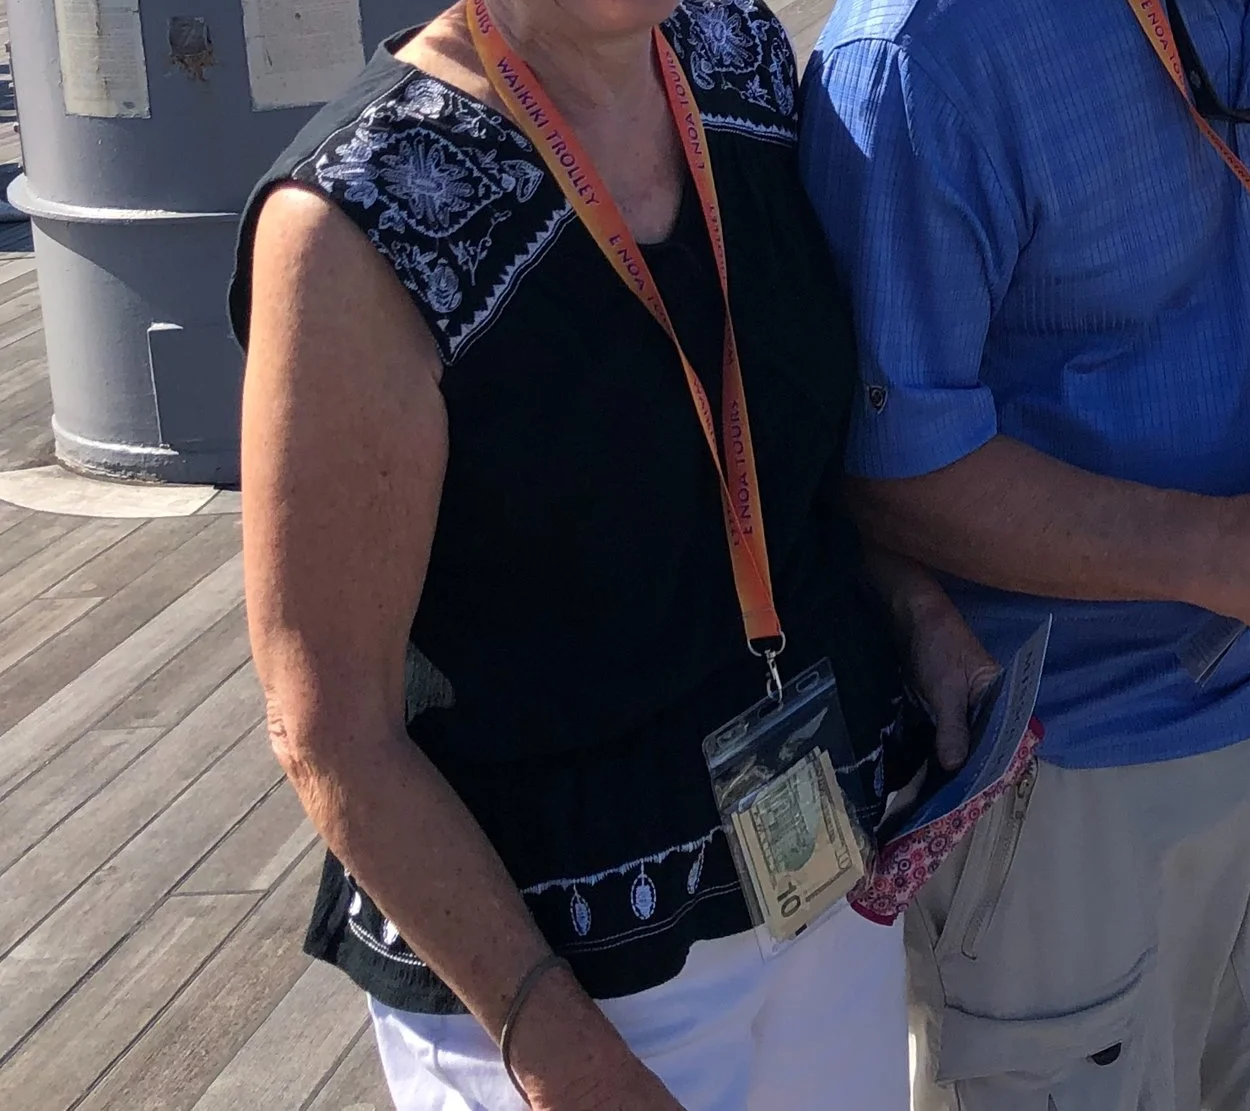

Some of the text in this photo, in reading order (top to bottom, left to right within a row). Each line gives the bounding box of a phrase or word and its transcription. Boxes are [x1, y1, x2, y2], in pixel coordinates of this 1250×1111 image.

[1141, 0, 1169, 51] E NOA
[685, 112, 702, 155] NOA
[496, 56, 549, 129] WAIKIKI
[546, 129, 601, 207] TROLLEY
[617, 248, 645, 292] NOA
[730, 399, 745, 467] TOURS
[738, 471, 753, 520] NOA
[776, 881, 801, 919] 10
